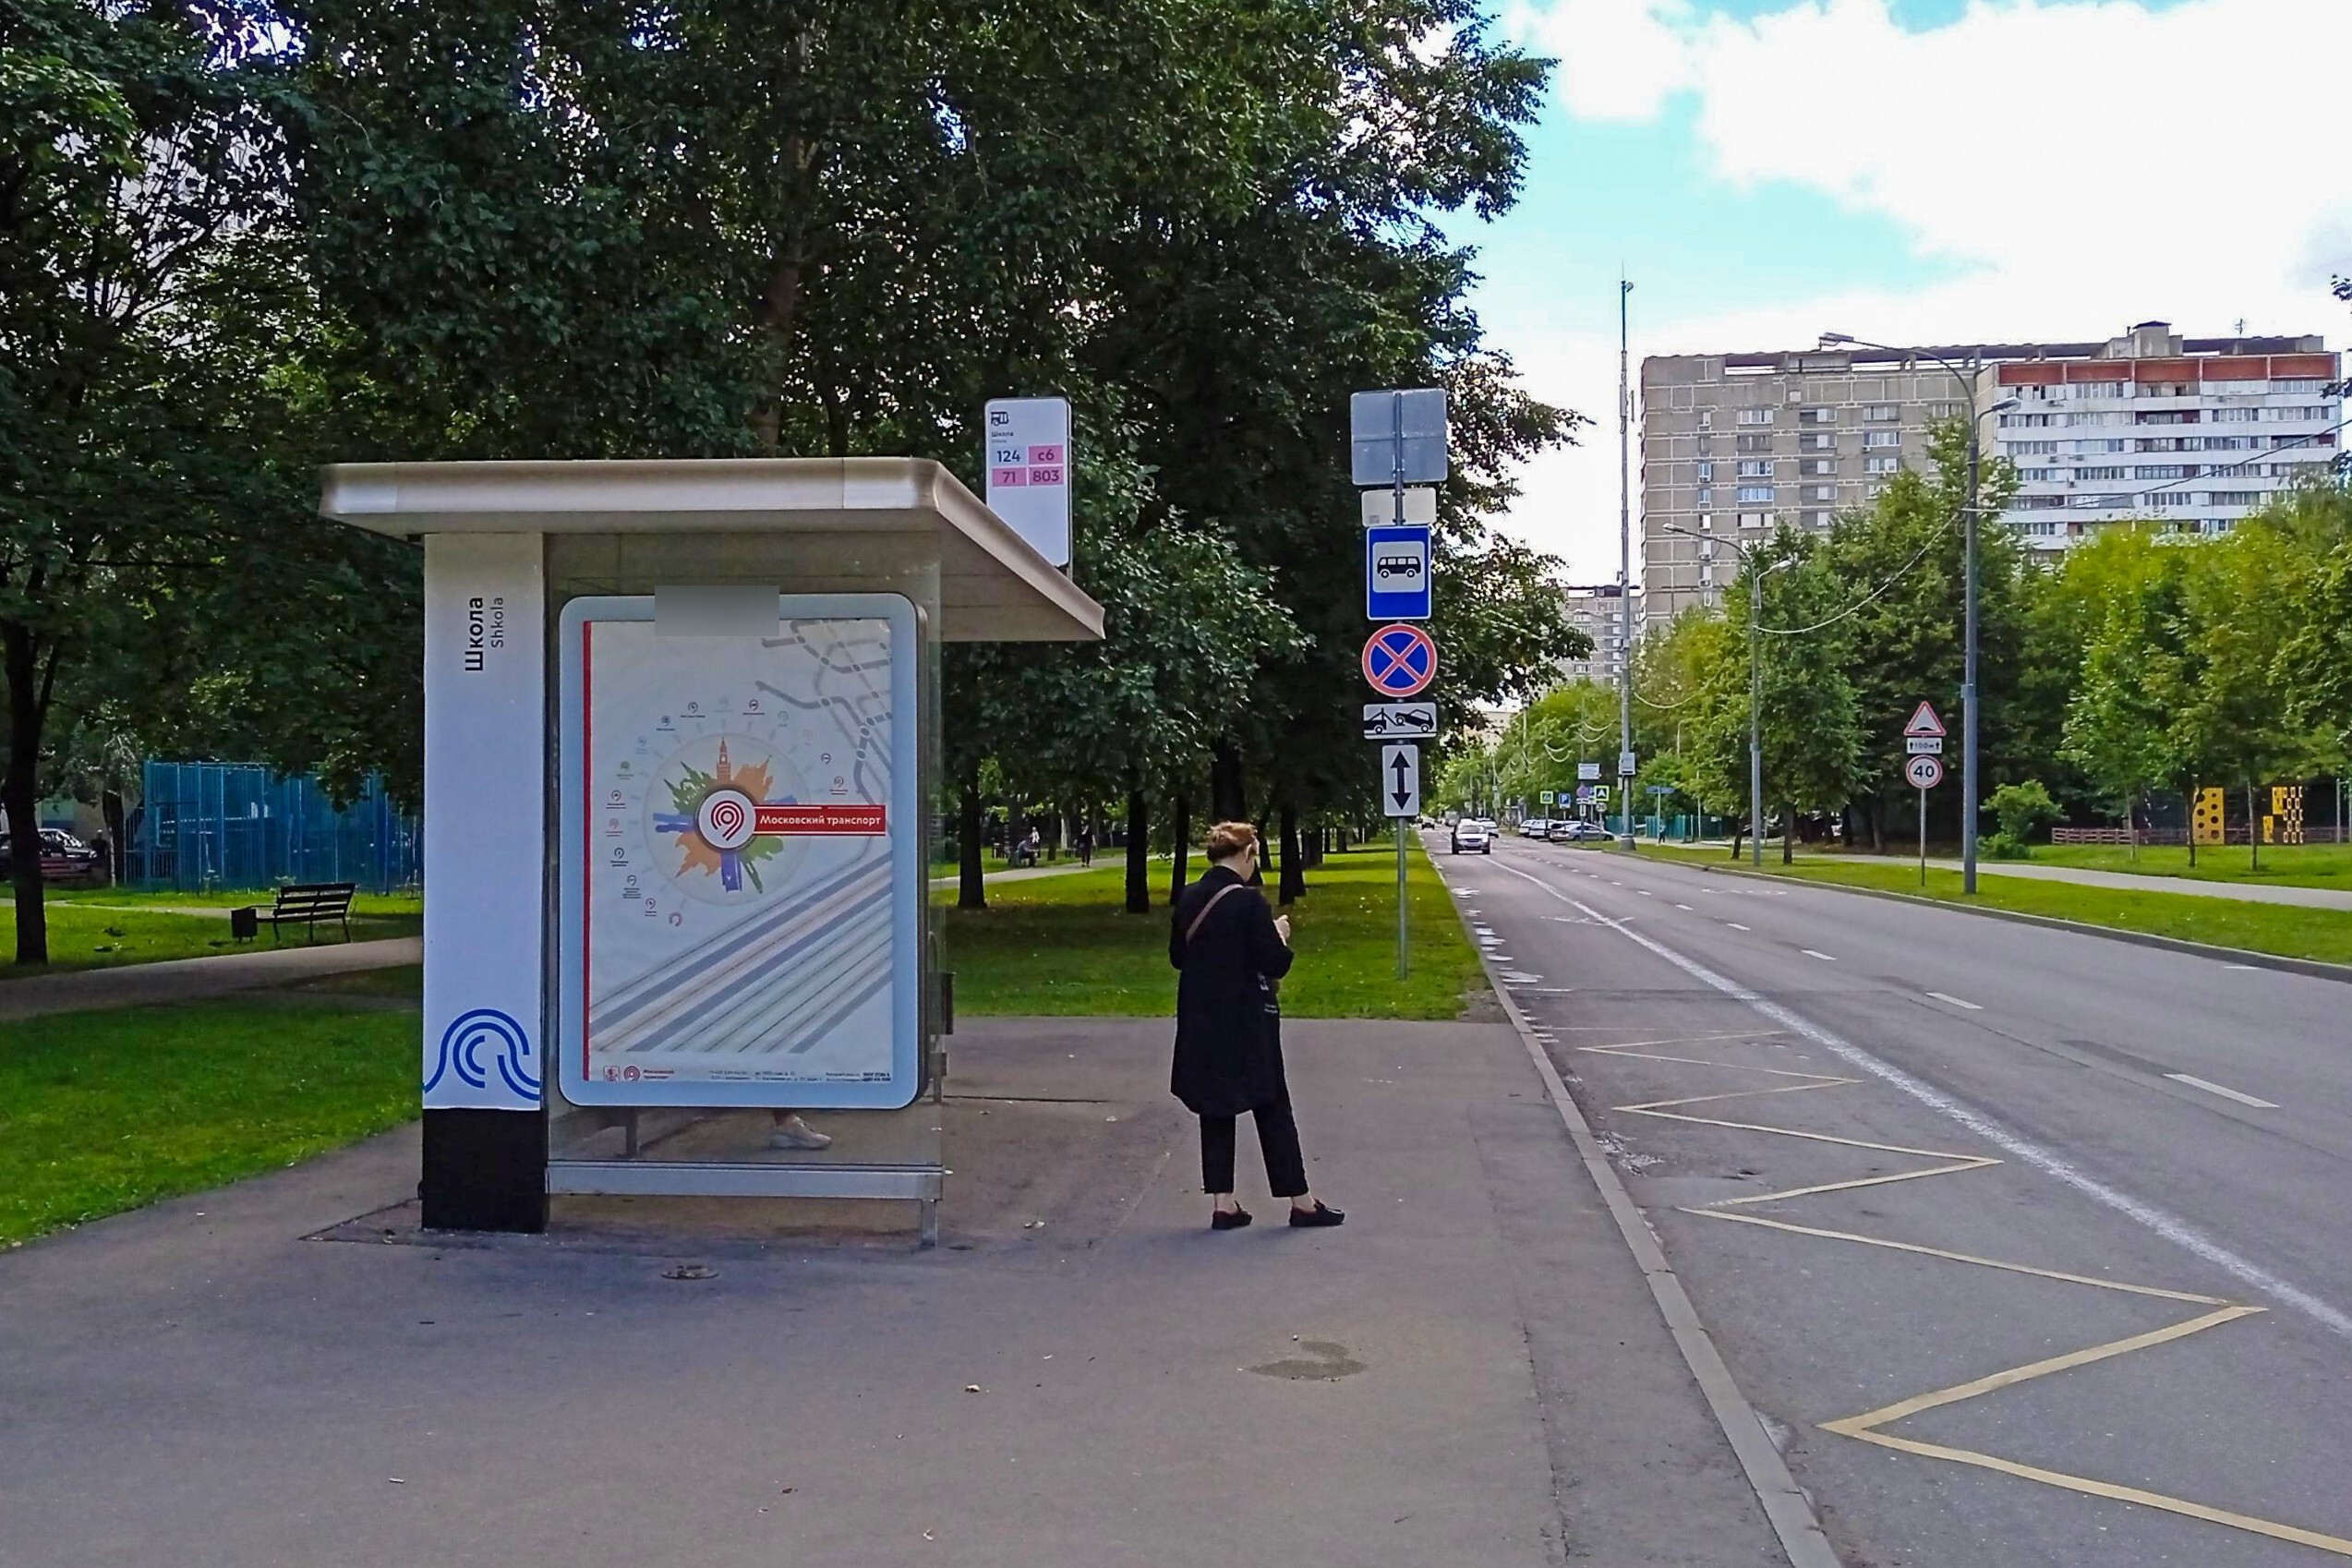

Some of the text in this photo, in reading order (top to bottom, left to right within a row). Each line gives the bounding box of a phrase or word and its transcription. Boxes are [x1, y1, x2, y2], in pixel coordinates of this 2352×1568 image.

[996, 450, 1020, 463] 124
[1003, 471, 1016, 483] 71
[1032, 470, 1060, 482] 803
[490, 597, 504, 648] Shkola
[464, 597, 484, 671] Школа
[1913, 765, 1935, 778] 40
[1561, 794, 1568, 803] P
[760, 814, 881, 827] Московский транспорт
